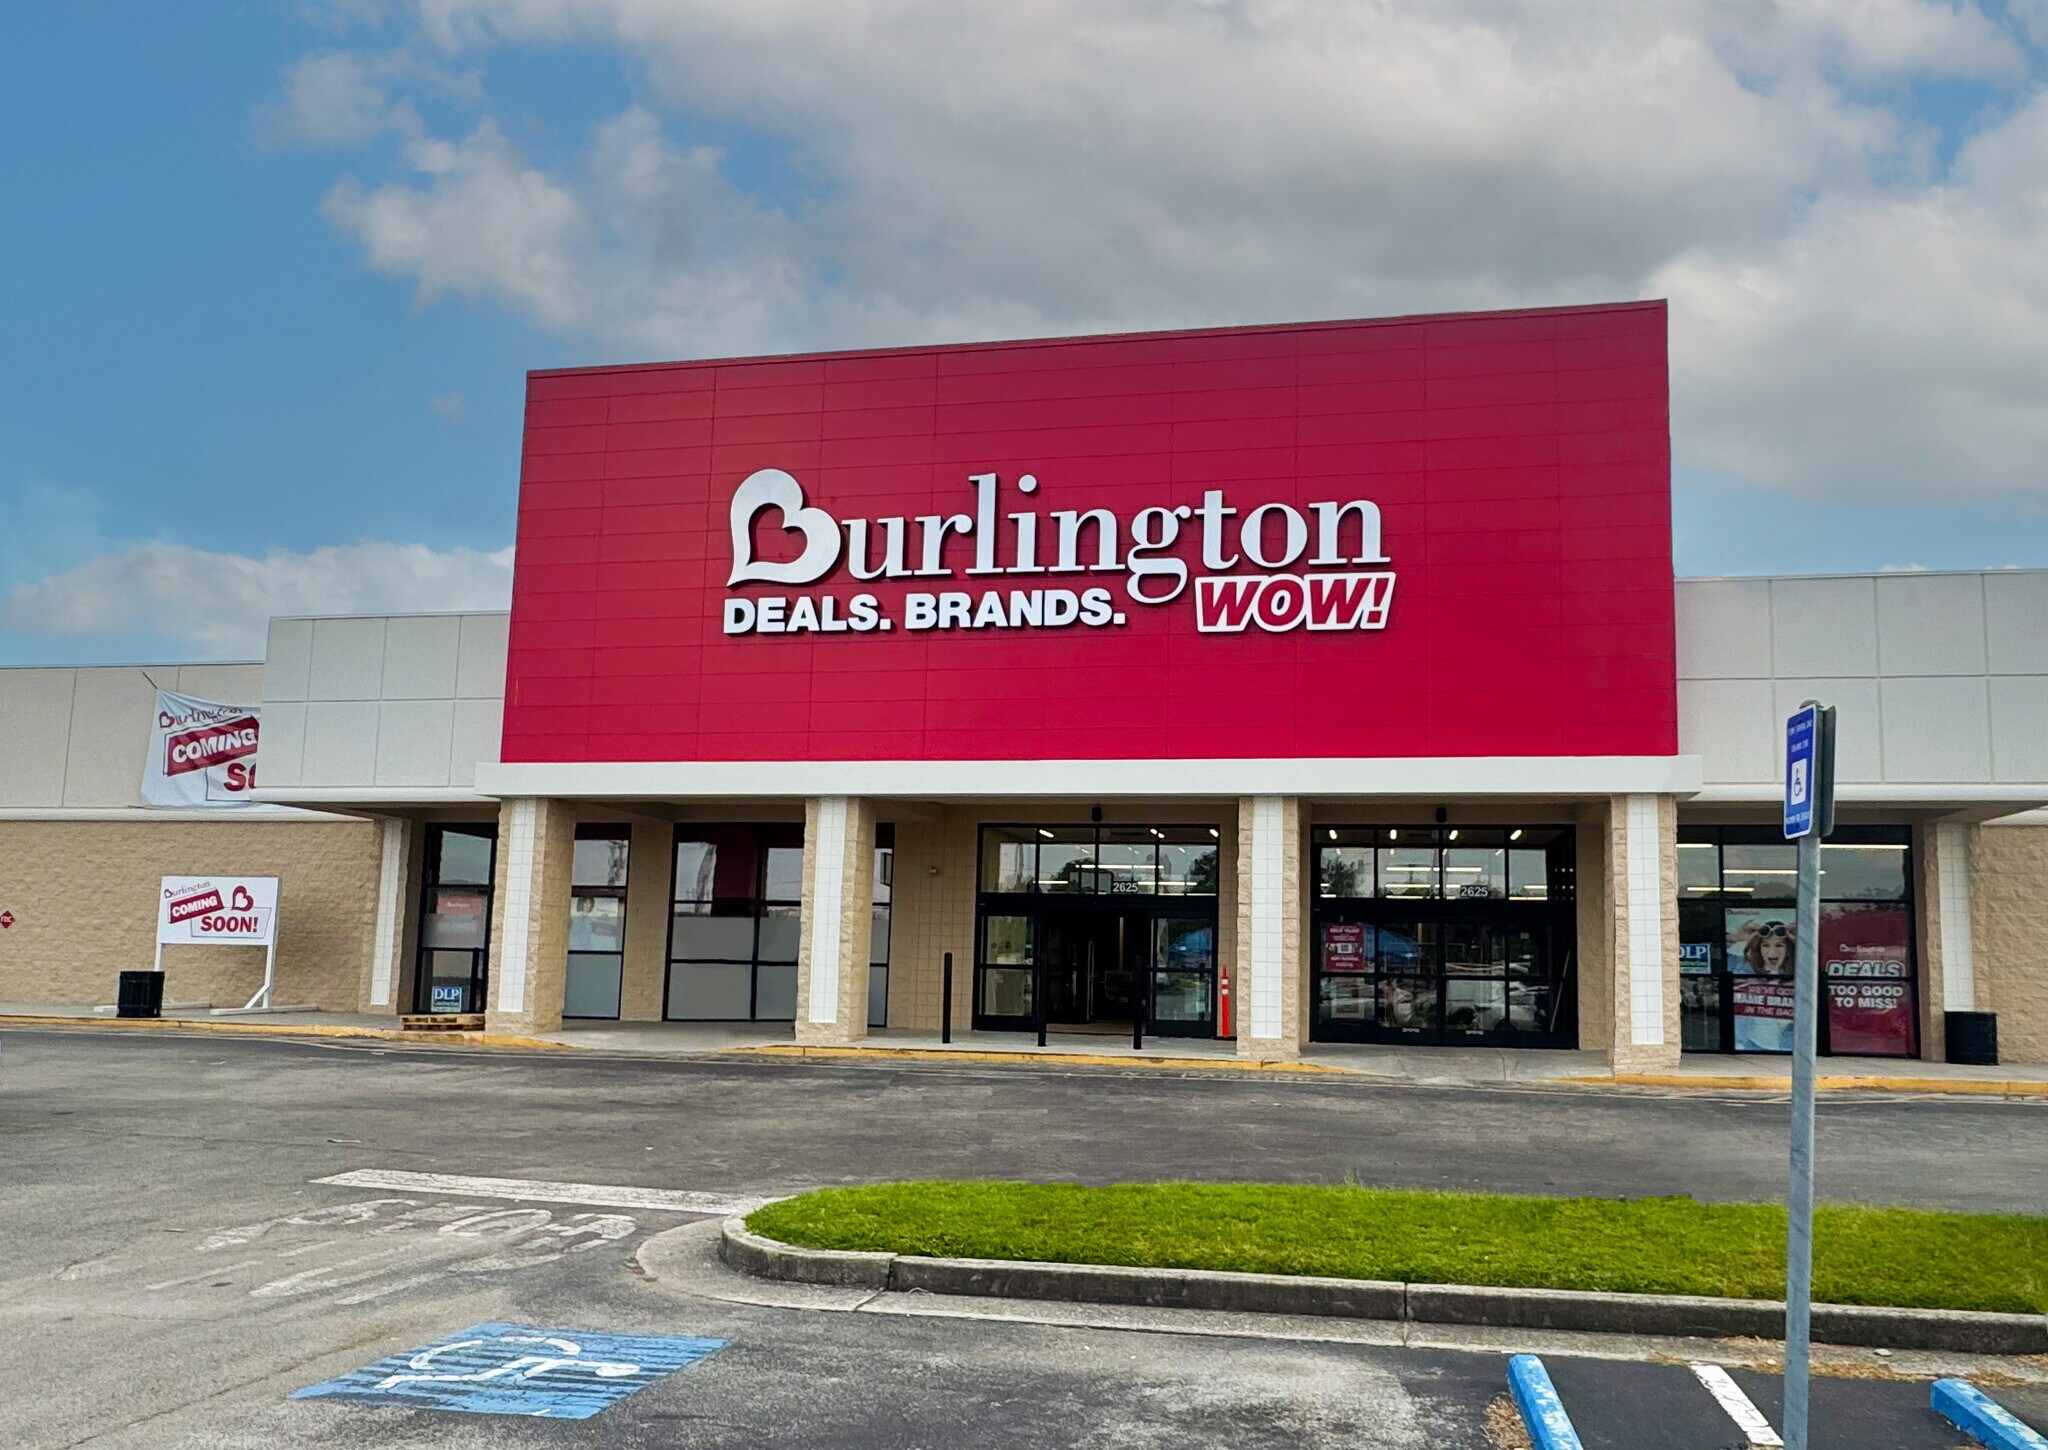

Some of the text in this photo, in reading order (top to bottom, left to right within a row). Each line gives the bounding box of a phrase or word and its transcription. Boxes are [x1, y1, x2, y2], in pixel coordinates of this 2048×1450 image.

[726, 467, 1391, 605] Burlington
[723, 573, 1394, 635] DEALS. BRANDS. WOW!
[171, 727, 258, 764] COMING
[1112, 881, 1139, 893] 2625
[1460, 886, 1489, 897] 2625
[171, 895, 219, 917] COMING
[200, 915, 259, 933] SOON!
[1827, 961, 1903, 977] DEALS
[434, 988, 459, 1000] DLP
[1828, 985, 1904, 997] TOO GOOD
[1835, 996, 1898, 1009] TO MISS!
